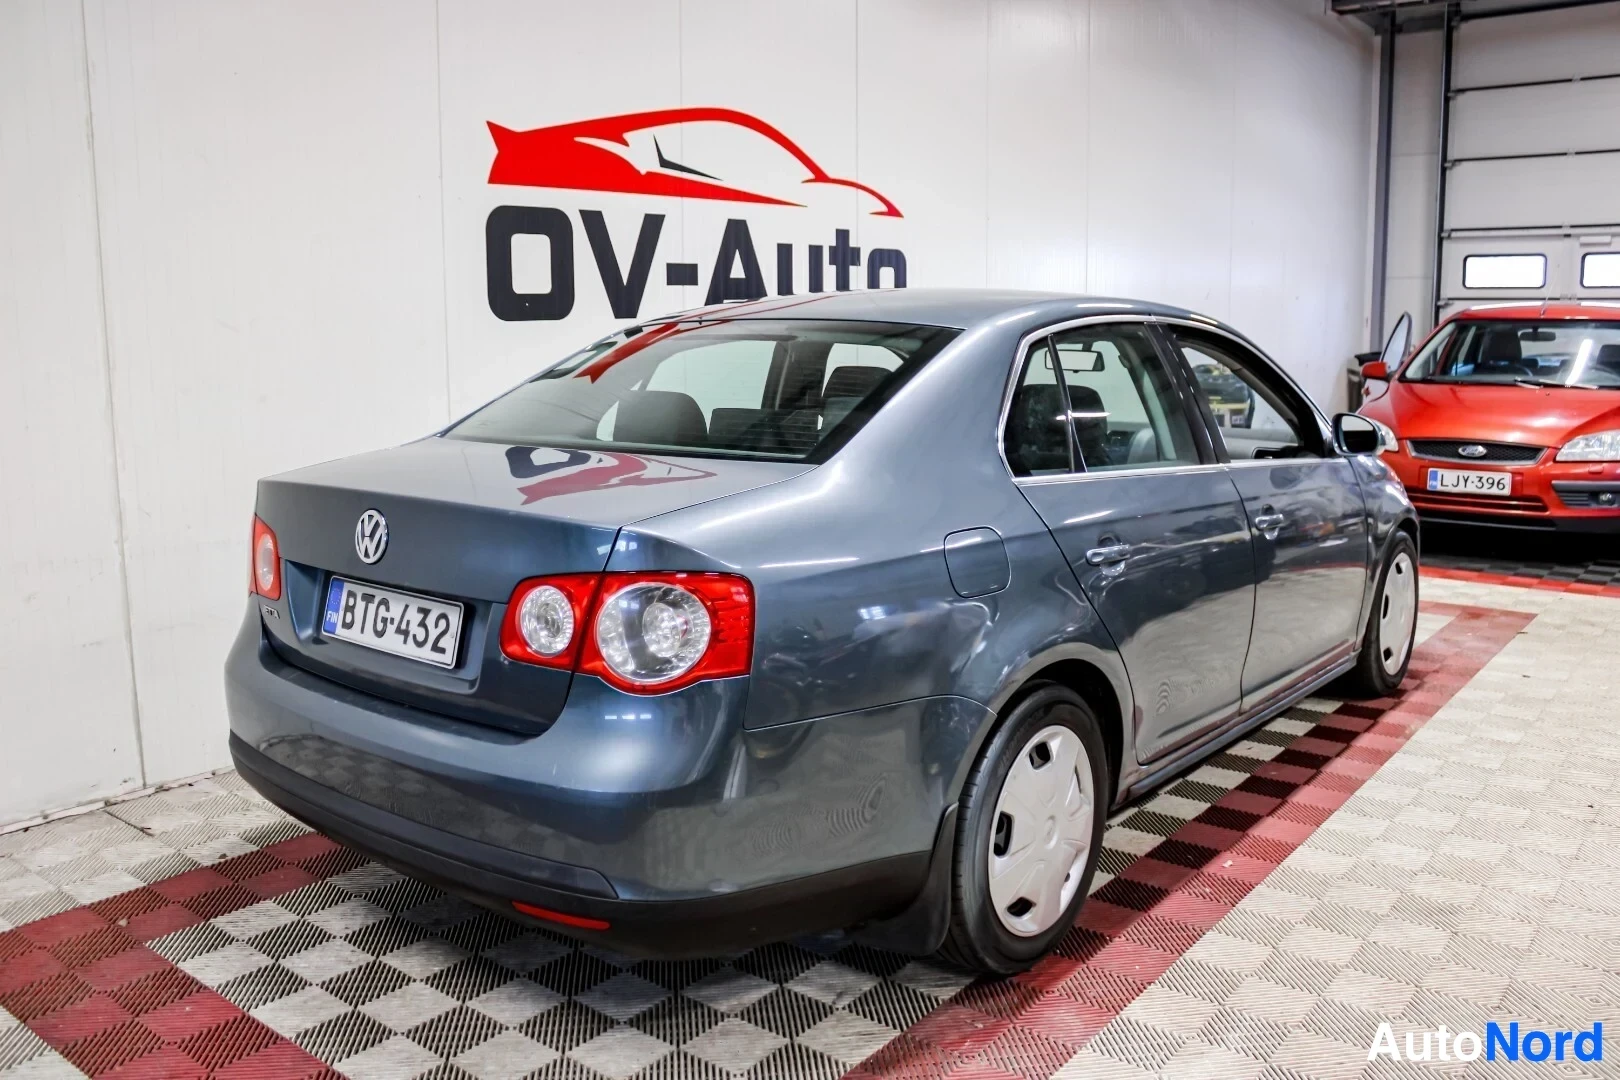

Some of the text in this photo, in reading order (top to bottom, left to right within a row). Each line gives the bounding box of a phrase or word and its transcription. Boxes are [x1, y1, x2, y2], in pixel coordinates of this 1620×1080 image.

[486, 205, 907, 321] OV-Auto
[1440, 473, 1506, 491] LJY-396
[326, 589, 450, 655] FIN BTG-432
